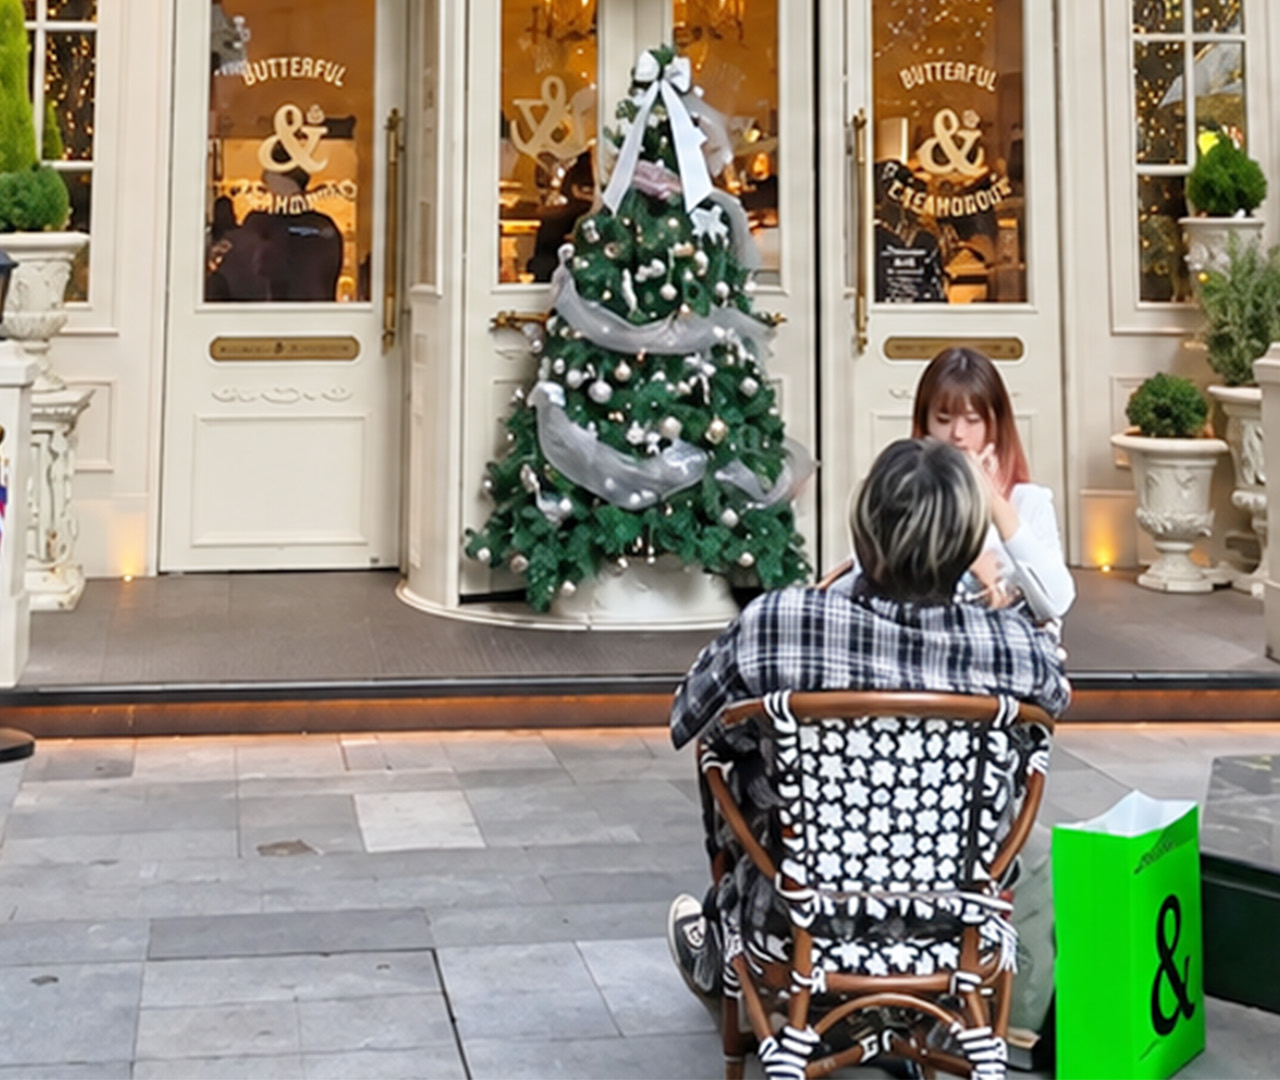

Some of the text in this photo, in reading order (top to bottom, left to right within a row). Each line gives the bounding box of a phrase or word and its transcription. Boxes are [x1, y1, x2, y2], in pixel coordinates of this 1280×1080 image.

[240, 56, 346, 87] BUTTERFUL
[899, 61, 997, 92] BUTTERFUL
[257, 103, 328, 174] &
[916, 108, 989, 177] &
[1151, 893, 1195, 1037] &
